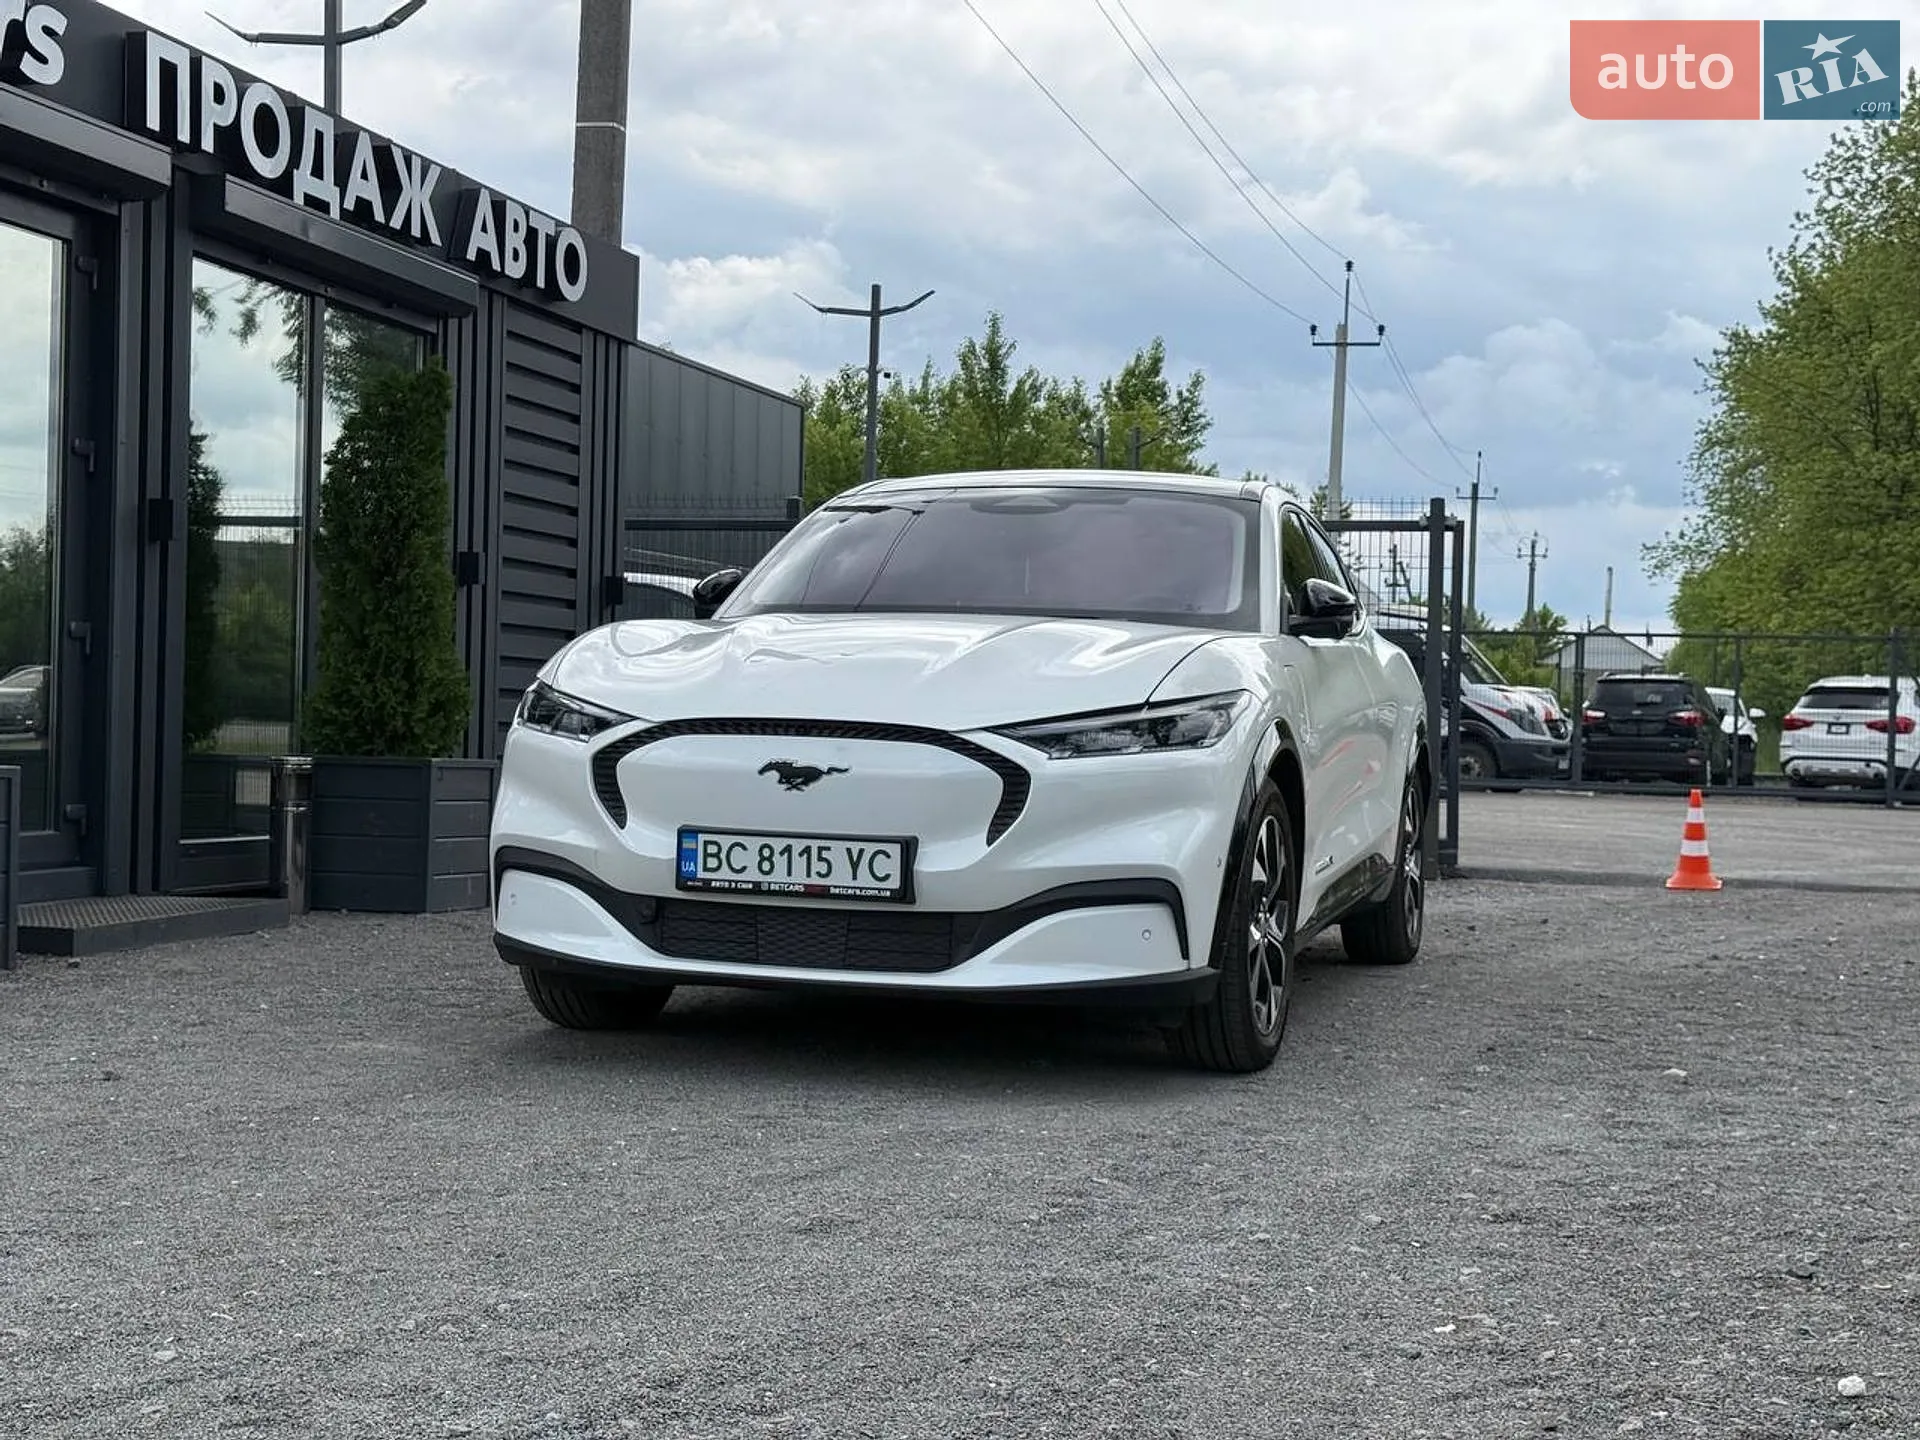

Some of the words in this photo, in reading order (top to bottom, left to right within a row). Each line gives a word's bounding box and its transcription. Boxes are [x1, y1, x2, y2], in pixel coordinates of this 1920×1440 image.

[145, 30, 442, 246] ПРОДАЖ
[466, 188, 588, 303] АВТО
[681, 860, 696, 873] UA
[702, 840, 749, 874] BC
[757, 843, 832, 879] 8115
[845, 847, 892, 883] YC
[829, 886, 891, 897] betcars.com.ua
